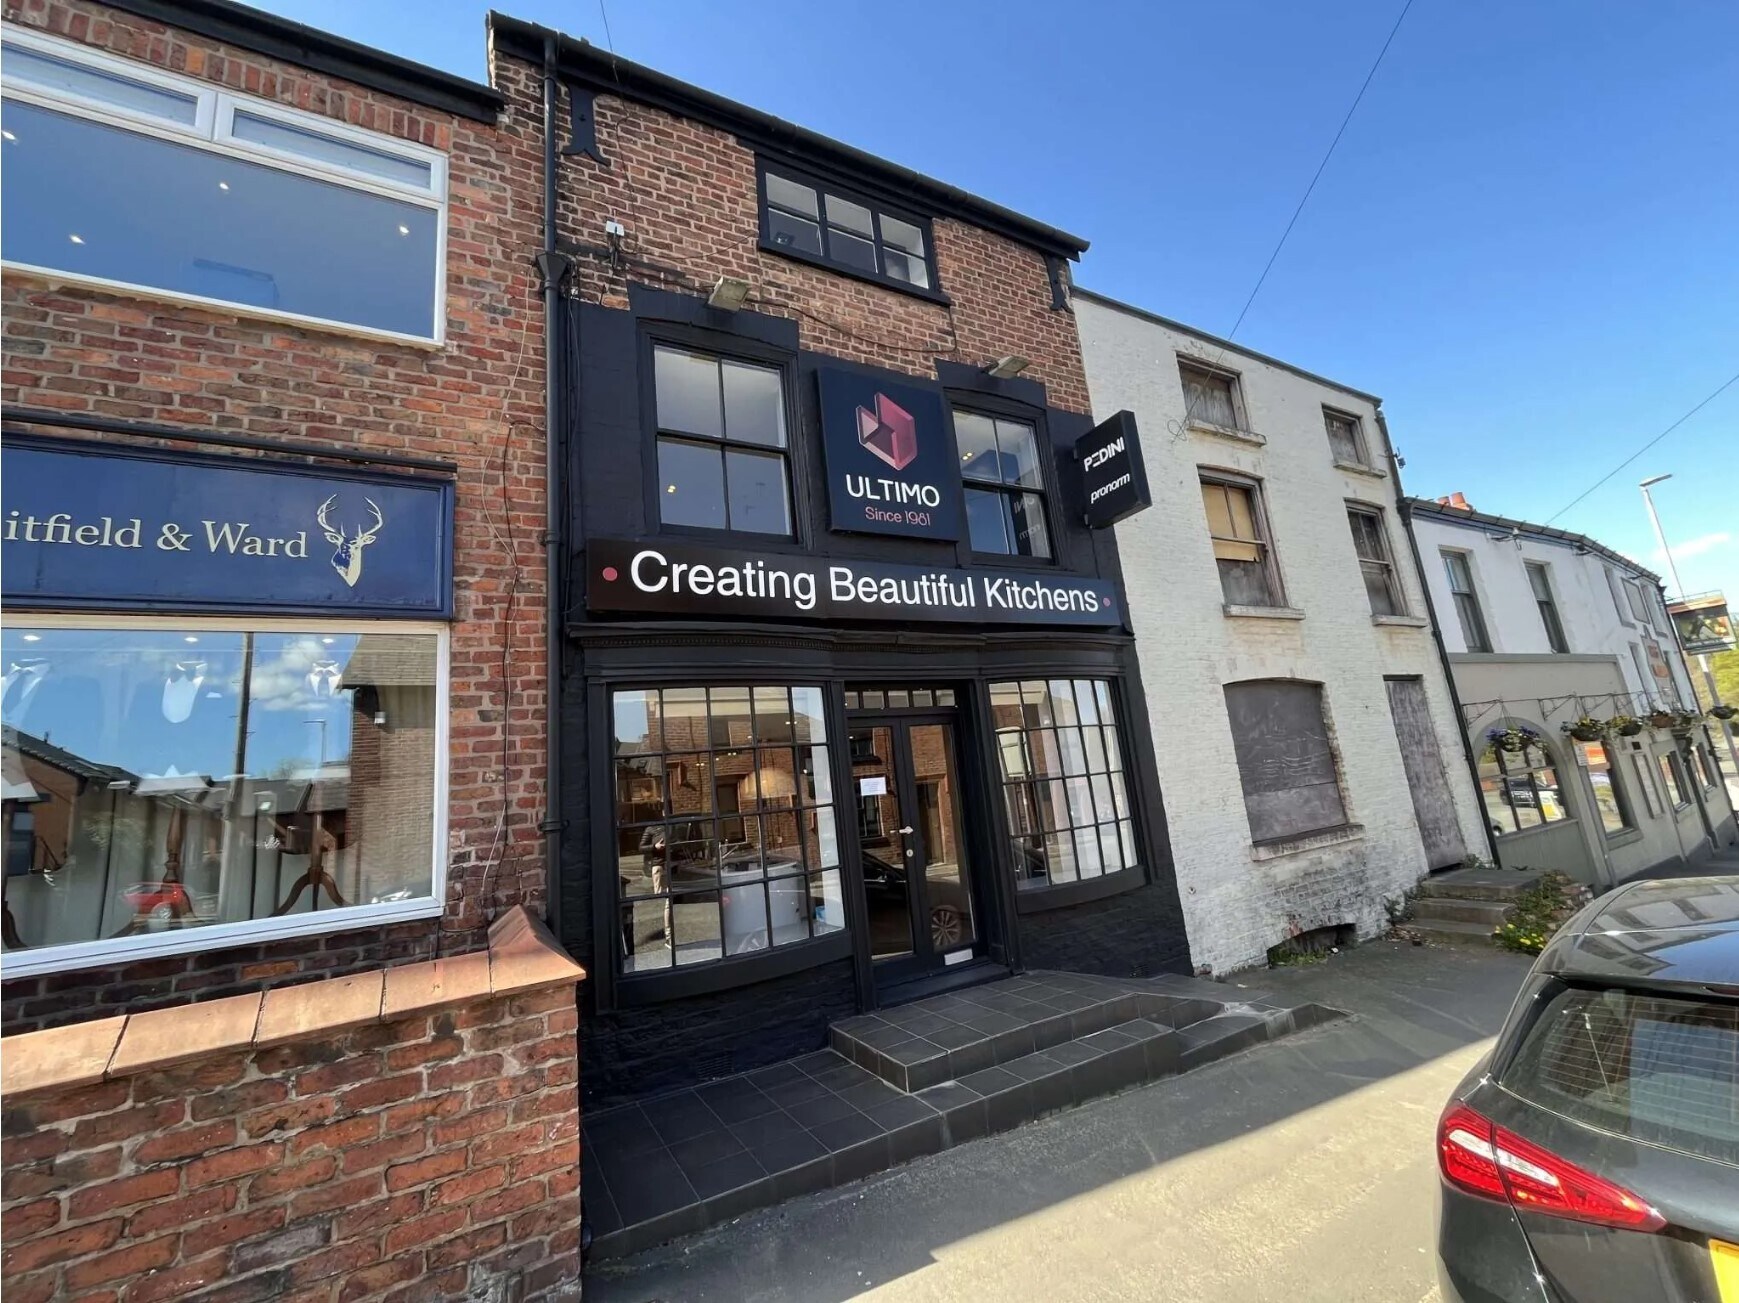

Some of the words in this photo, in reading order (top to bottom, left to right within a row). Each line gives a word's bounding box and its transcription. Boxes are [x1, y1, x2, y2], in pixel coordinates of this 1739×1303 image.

[1083, 436, 1125, 472] PEDINI
[845, 474, 940, 507] ULTIMO
[1090, 473, 1131, 504] pronorm
[865, 506, 902, 523] Since
[905, 510, 931, 526] 1981
[156, 523, 193, 551] &
[202, 520, 308, 558] Ward
[630, 550, 817, 610] Creating
[829, 566, 976, 608] Beautiful
[983, 577, 1099, 613] Kitchens
